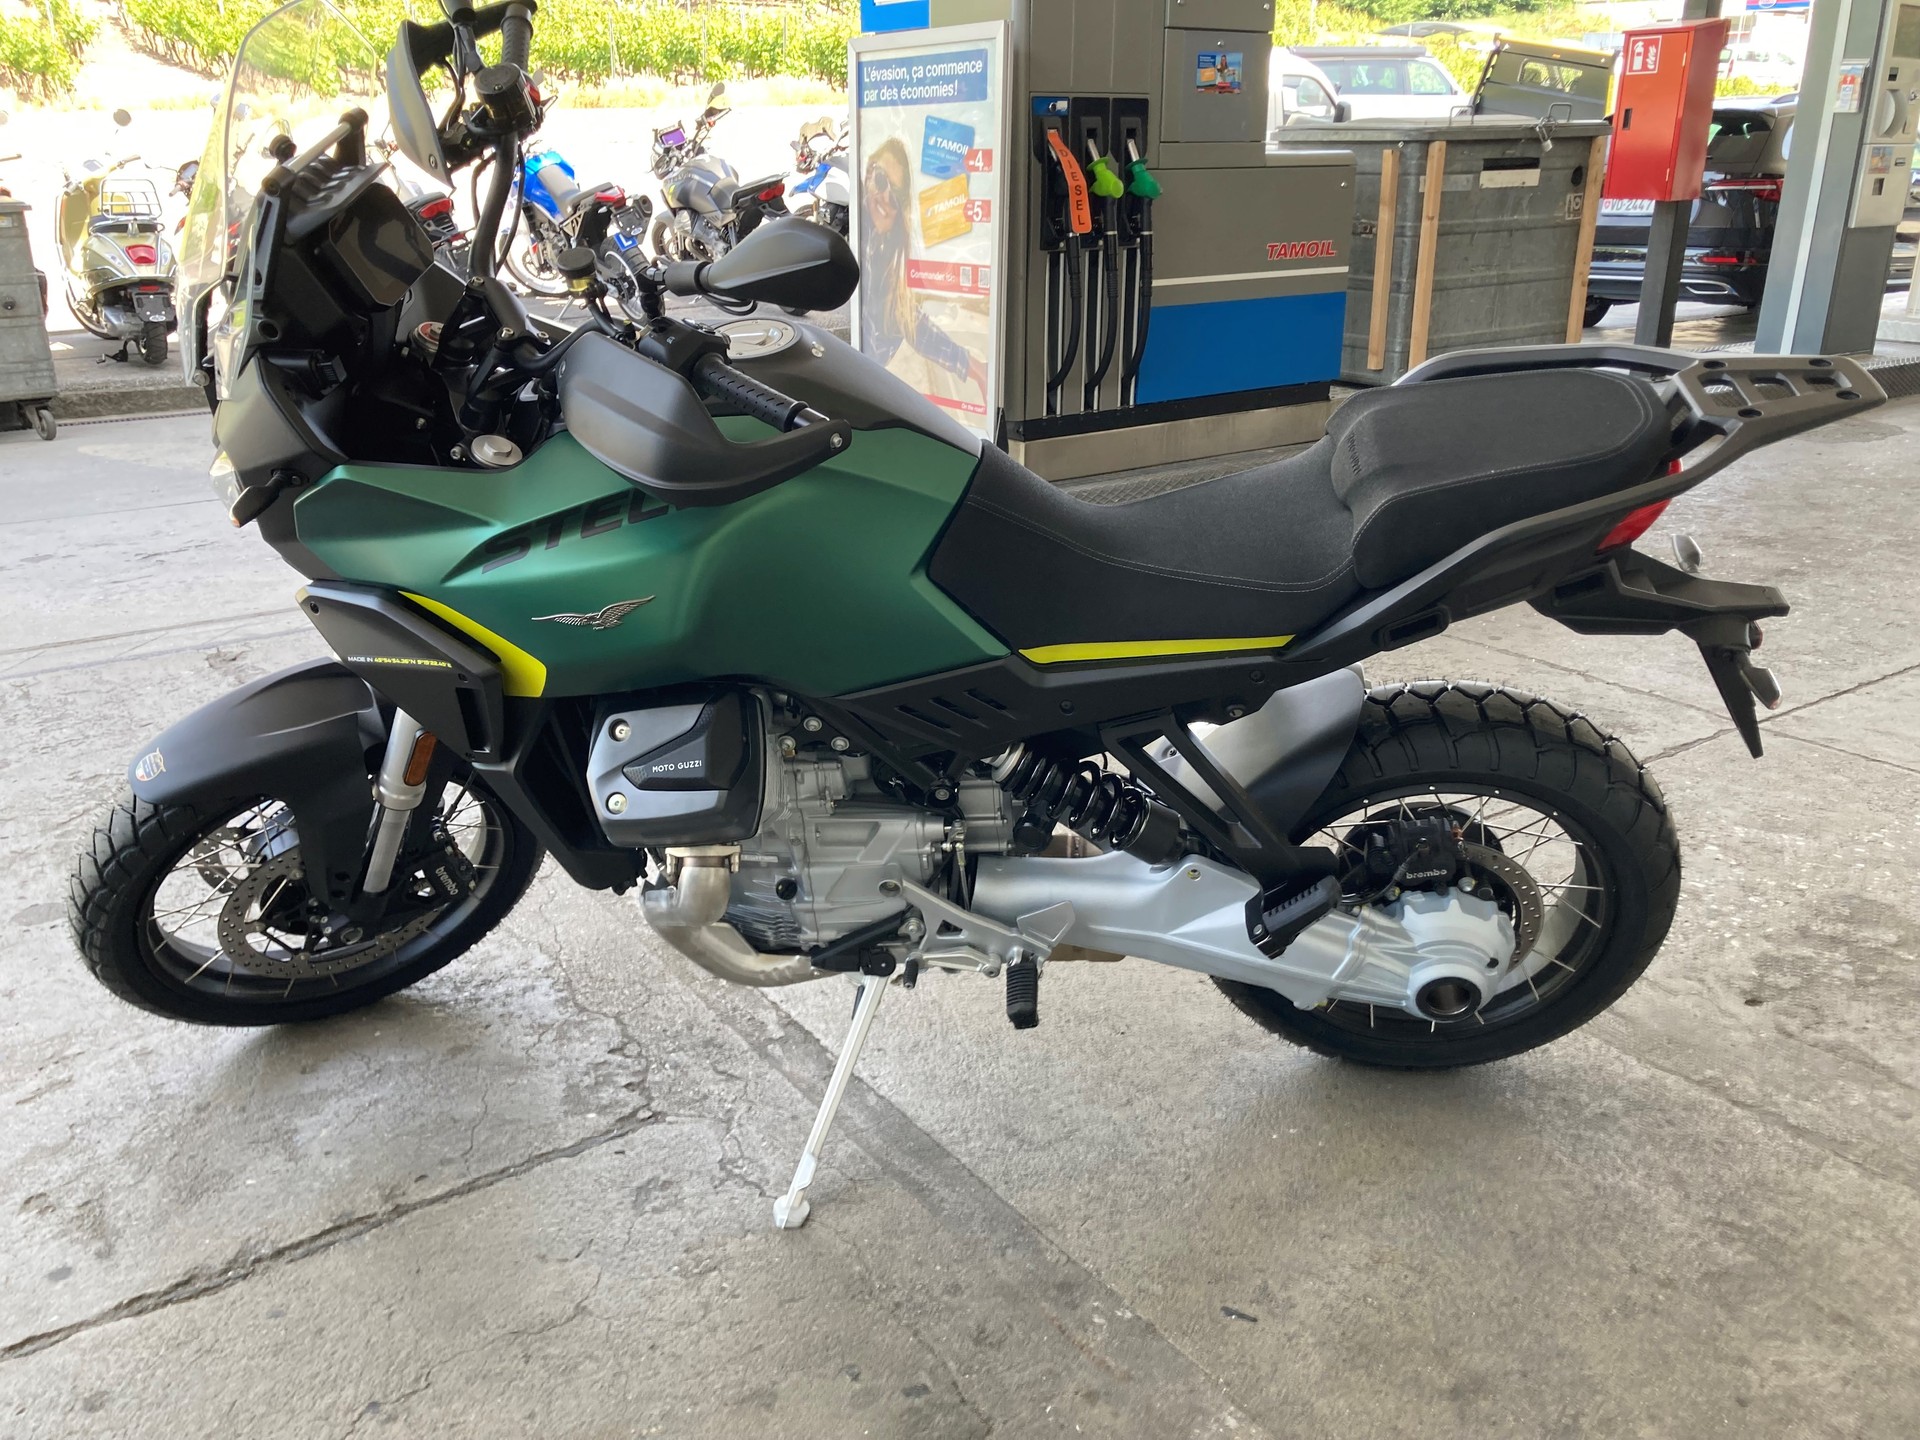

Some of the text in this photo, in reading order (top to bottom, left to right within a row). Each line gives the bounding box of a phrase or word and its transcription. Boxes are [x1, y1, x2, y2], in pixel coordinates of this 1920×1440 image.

[912, 65, 923, 83] ça
[926, 60, 982, 78] commence
[864, 89, 878, 105] par
[880, 85, 898, 101] des
[1060, 149, 1085, 226] DIESEL
[1267, 240, 1336, 260] TAMOIL
[481, 487, 681, 575] STEL
[652, 760, 702, 773] MOTO GUZZI
[435, 865, 459, 895] brembo
[1406, 869, 1447, 879] brembo
